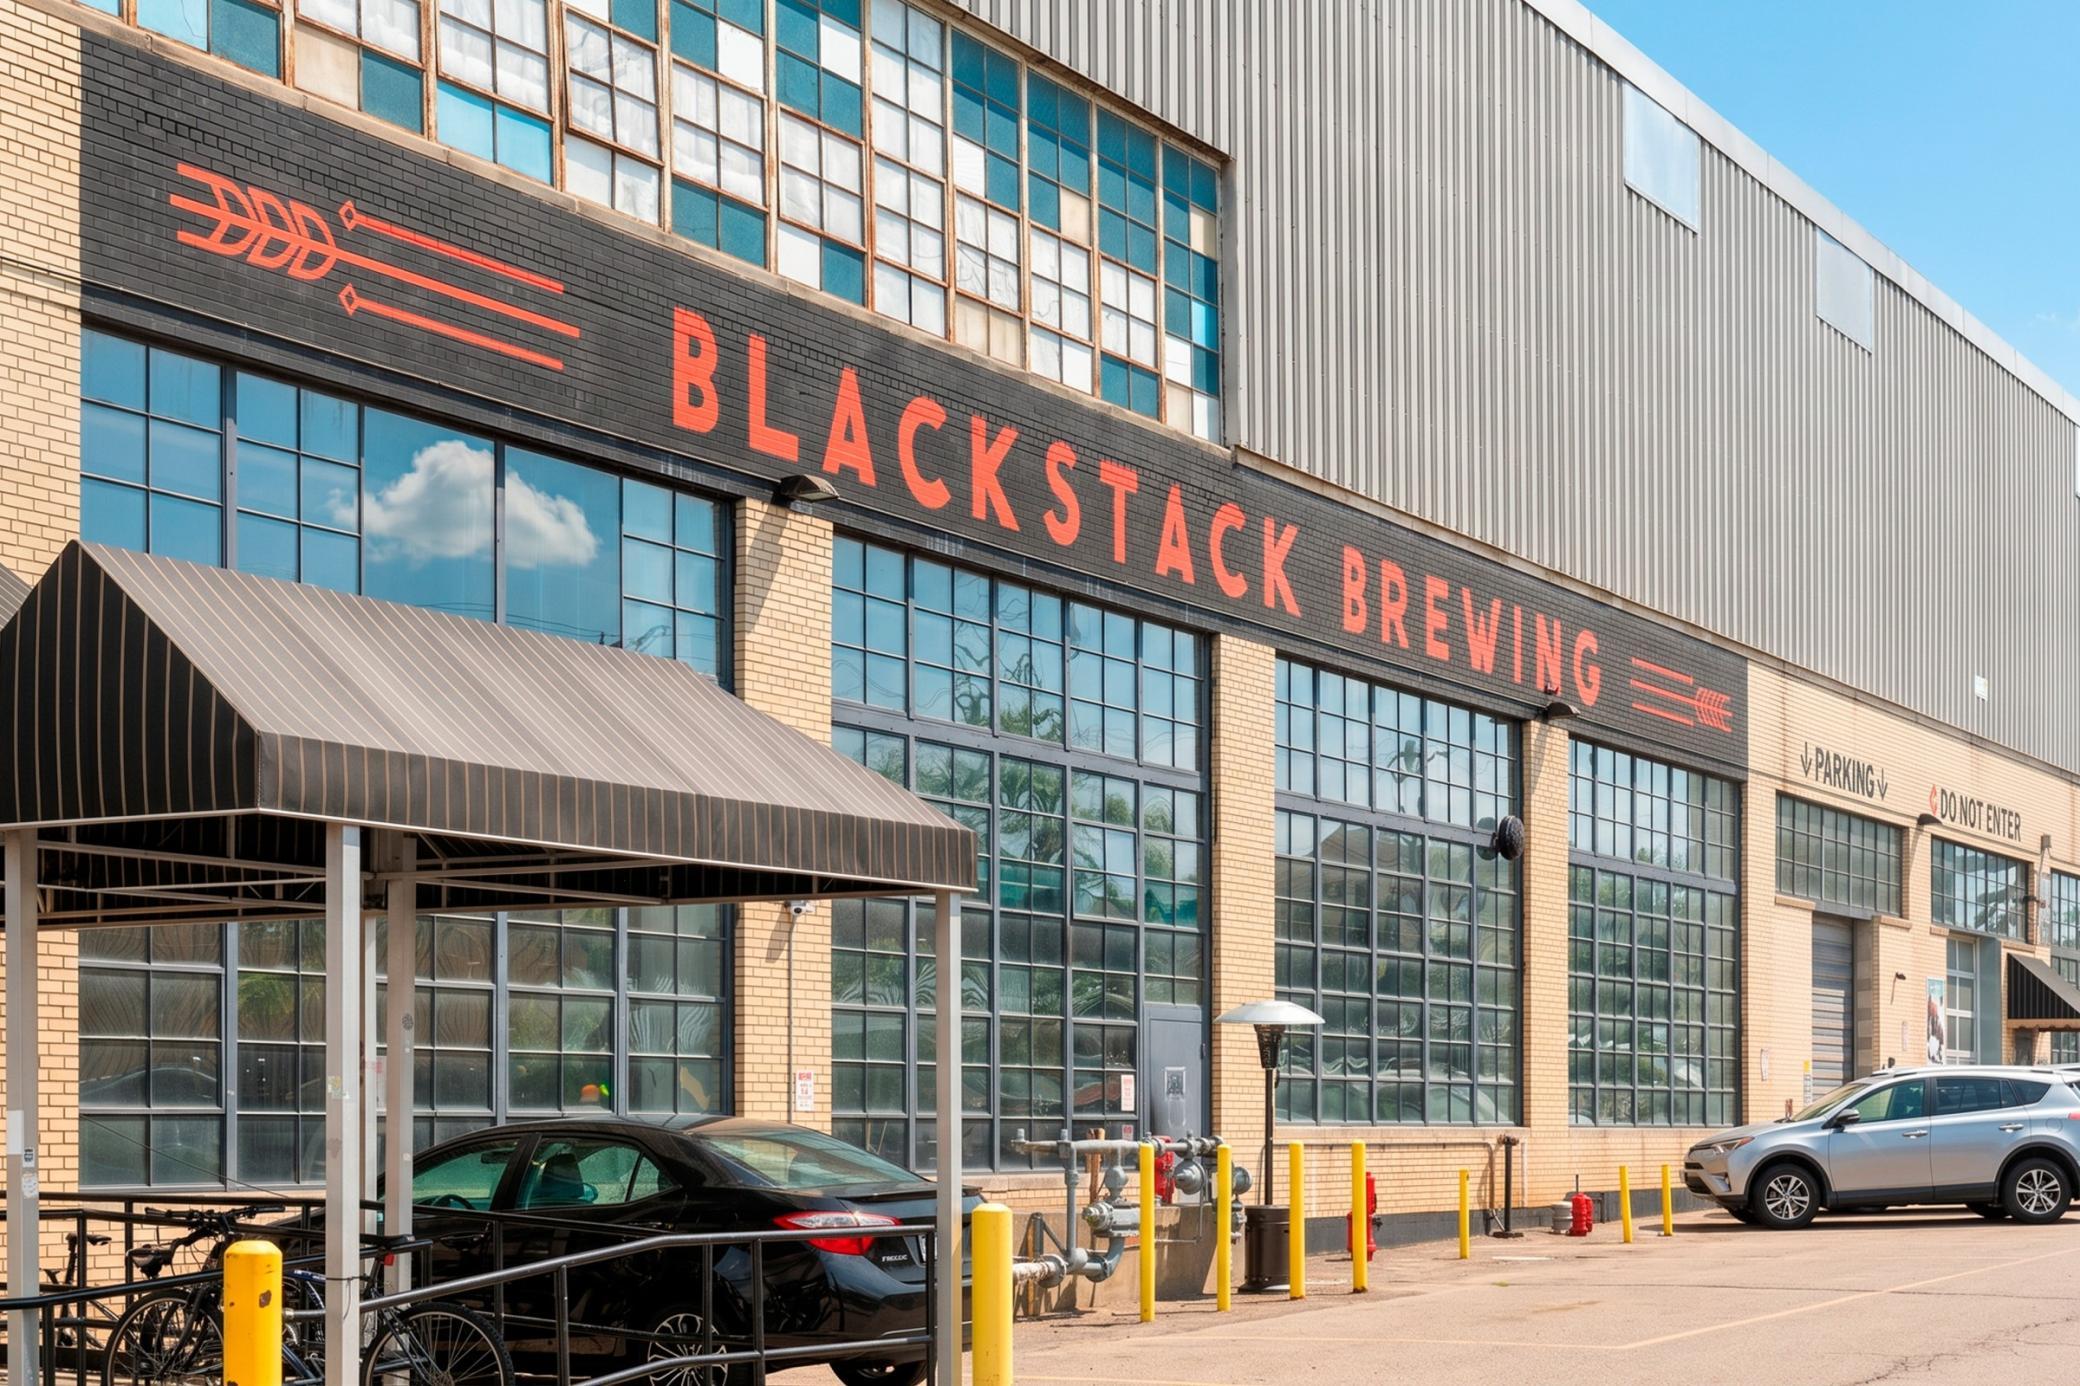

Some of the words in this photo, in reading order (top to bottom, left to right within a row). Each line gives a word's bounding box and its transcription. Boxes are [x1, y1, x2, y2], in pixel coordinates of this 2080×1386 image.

[673, 307, 1302, 618] BLACKSTACK
[1342, 546, 1601, 706] BREWING
[1815, 747, 1875, 799] PARKING
[1941, 788, 1957, 822] DO
[1960, 795, 1984, 831] NOT
[1986, 803, 2021, 842] ENTER
